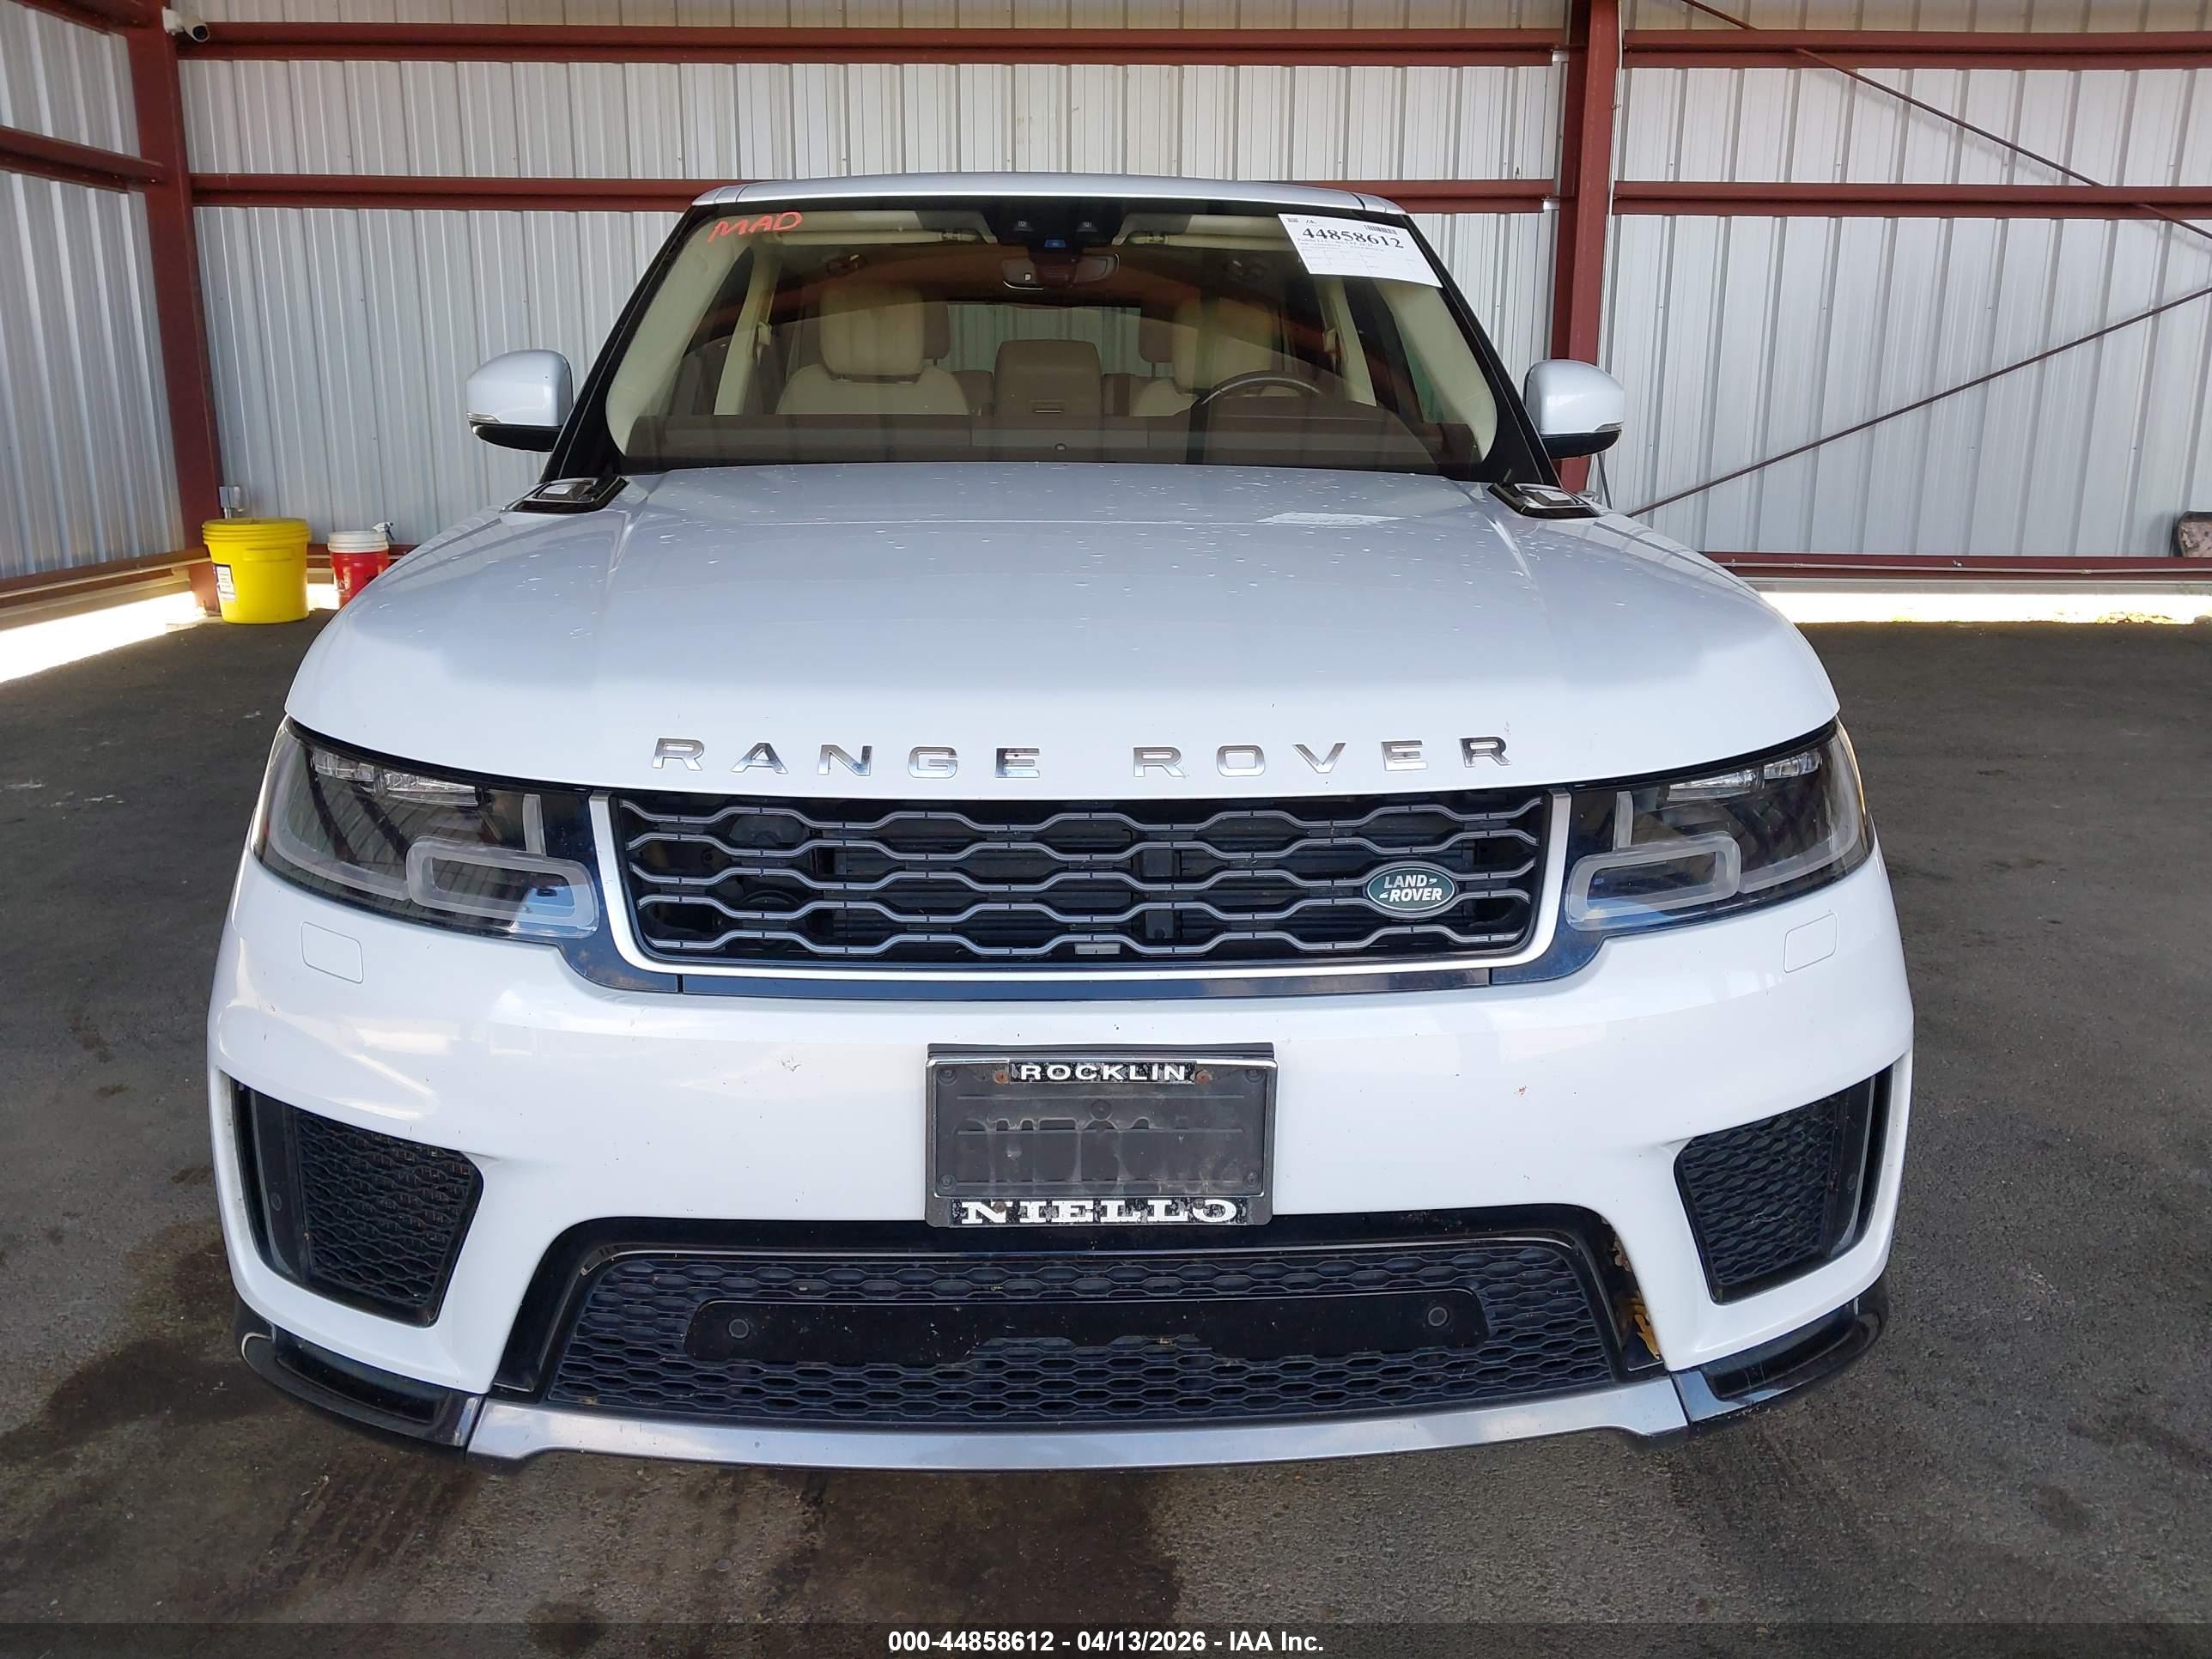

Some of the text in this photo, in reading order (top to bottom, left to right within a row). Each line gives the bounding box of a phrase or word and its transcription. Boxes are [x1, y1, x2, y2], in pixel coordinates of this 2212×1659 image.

[707, 211, 803, 244] MAD
[1302, 228, 1404, 249] 44858612
[652, 736, 1512, 778] RANGE ROVER
[1384, 874, 1427, 889] LAND
[1389, 888, 1443, 902] ROVER
[1020, 1064, 1186, 1081] ROCKLIN
[961, 1199, 1237, 1225] NIELLO
